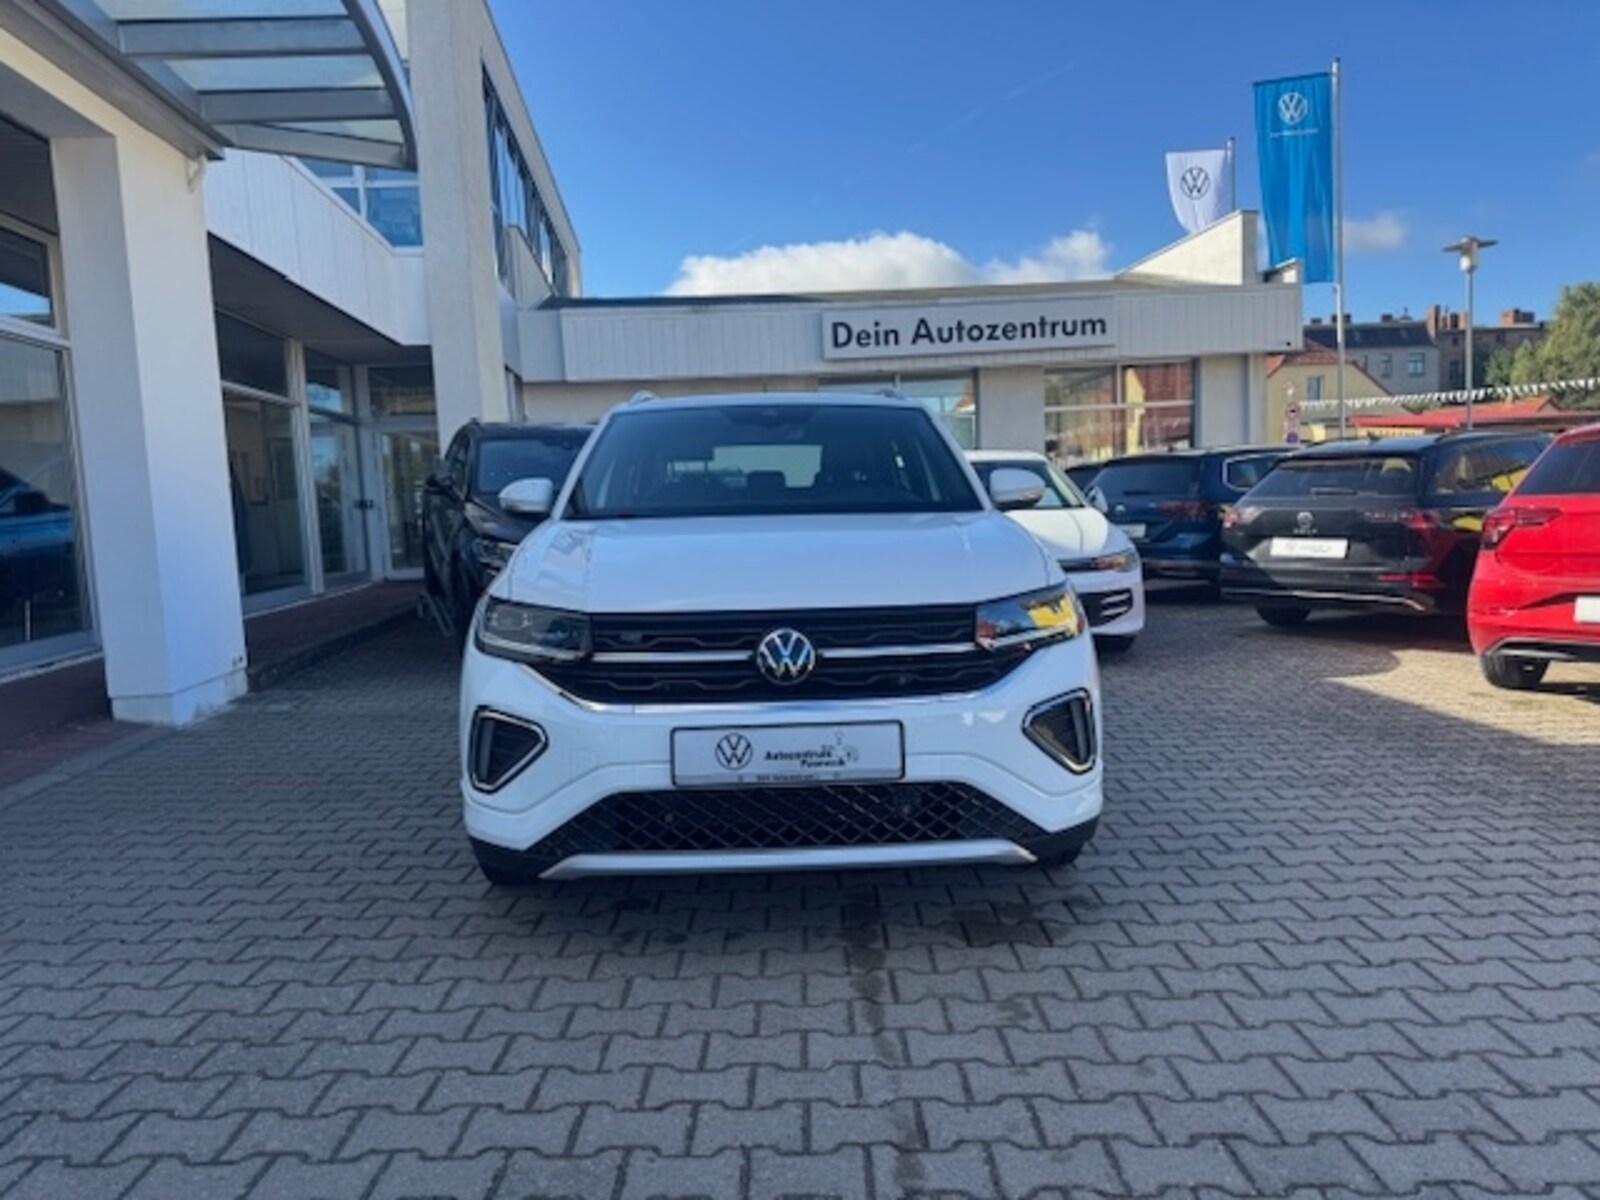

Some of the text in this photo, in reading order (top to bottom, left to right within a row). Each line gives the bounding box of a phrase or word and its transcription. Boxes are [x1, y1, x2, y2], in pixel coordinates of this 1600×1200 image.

[1278, 92, 1308, 124] VW
[1180, 167, 1210, 200] VW
[831, 315, 1108, 348] Dein Autozentrum
[758, 628, 815, 685] VW
[715, 732, 752, 770] VW
